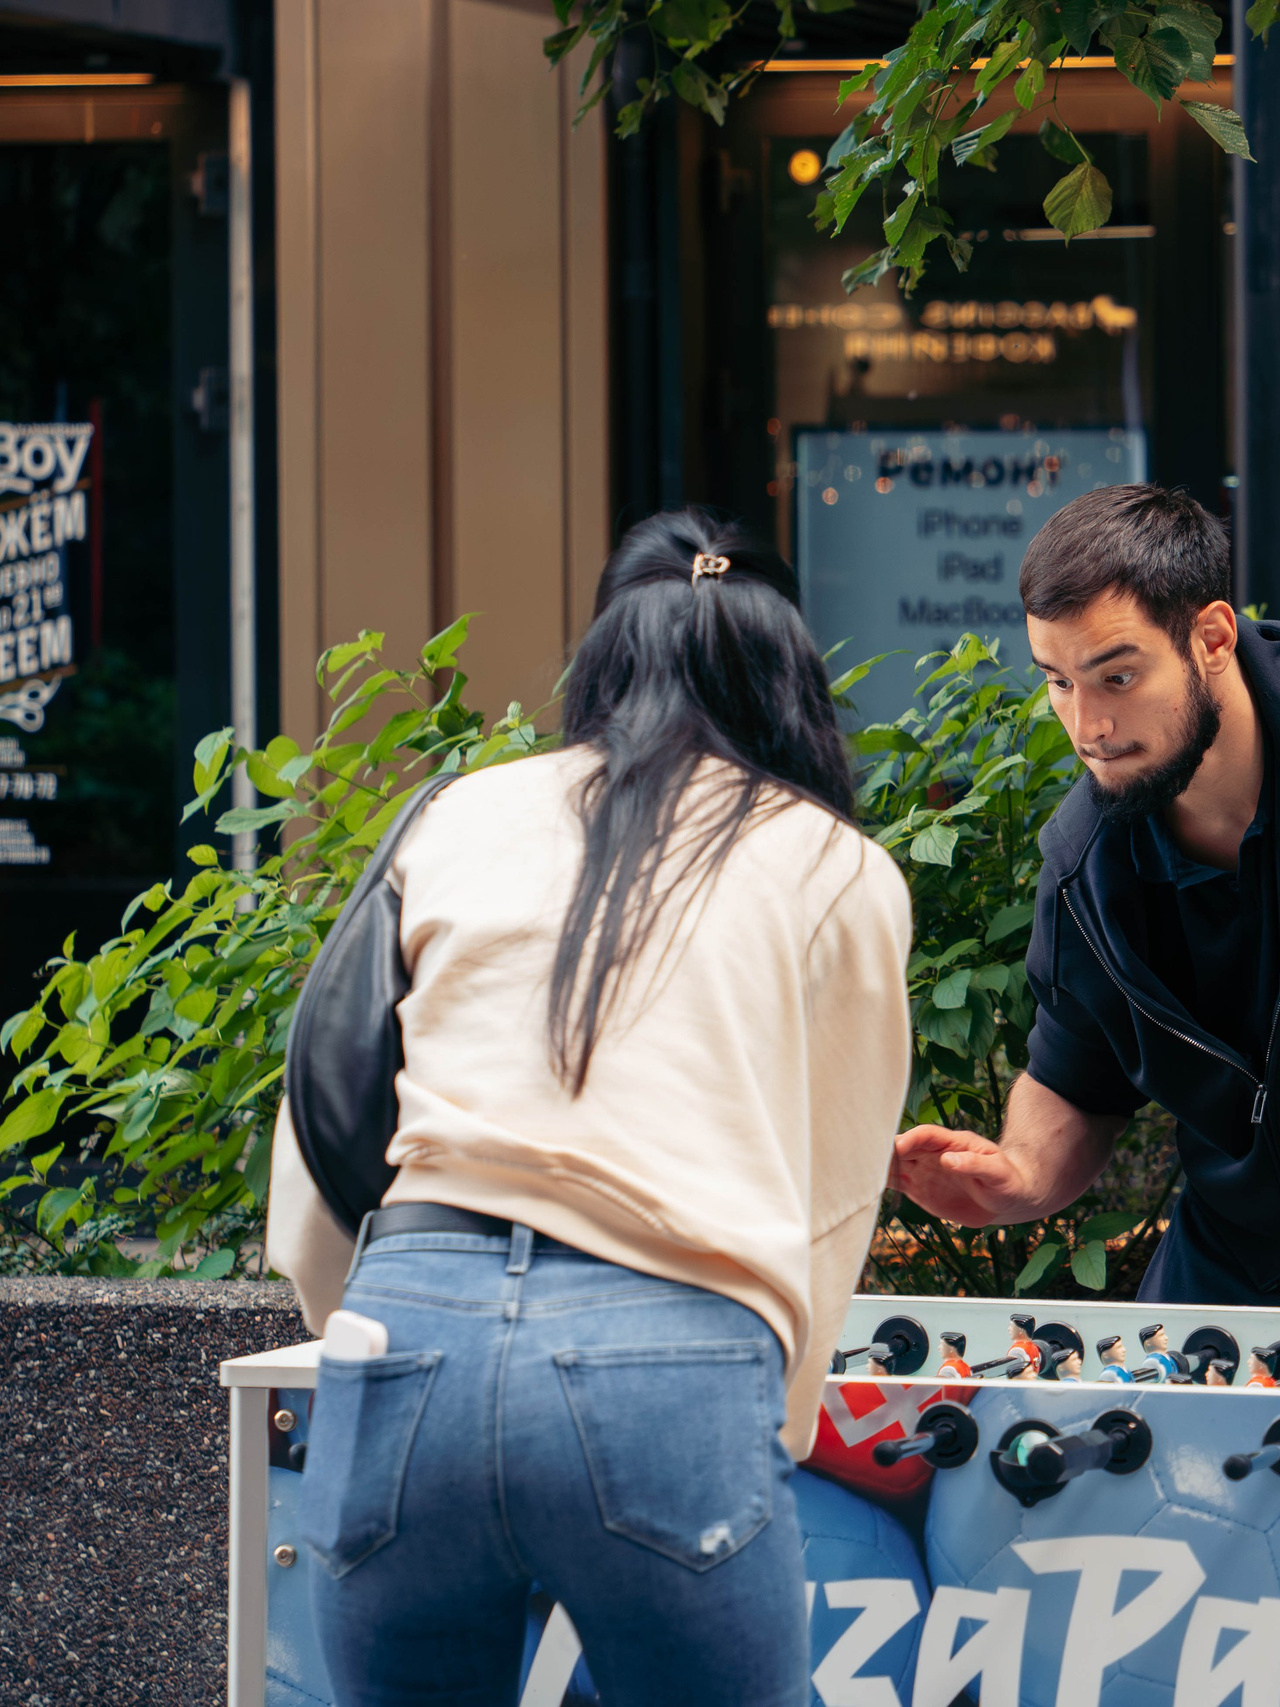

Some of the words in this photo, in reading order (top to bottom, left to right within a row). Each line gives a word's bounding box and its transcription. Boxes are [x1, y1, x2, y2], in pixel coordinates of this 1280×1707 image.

[917, 506, 1024, 540] iPhone
[937, 552, 1005, 583] iPad
[899, 596, 1026, 628] MacBoo
